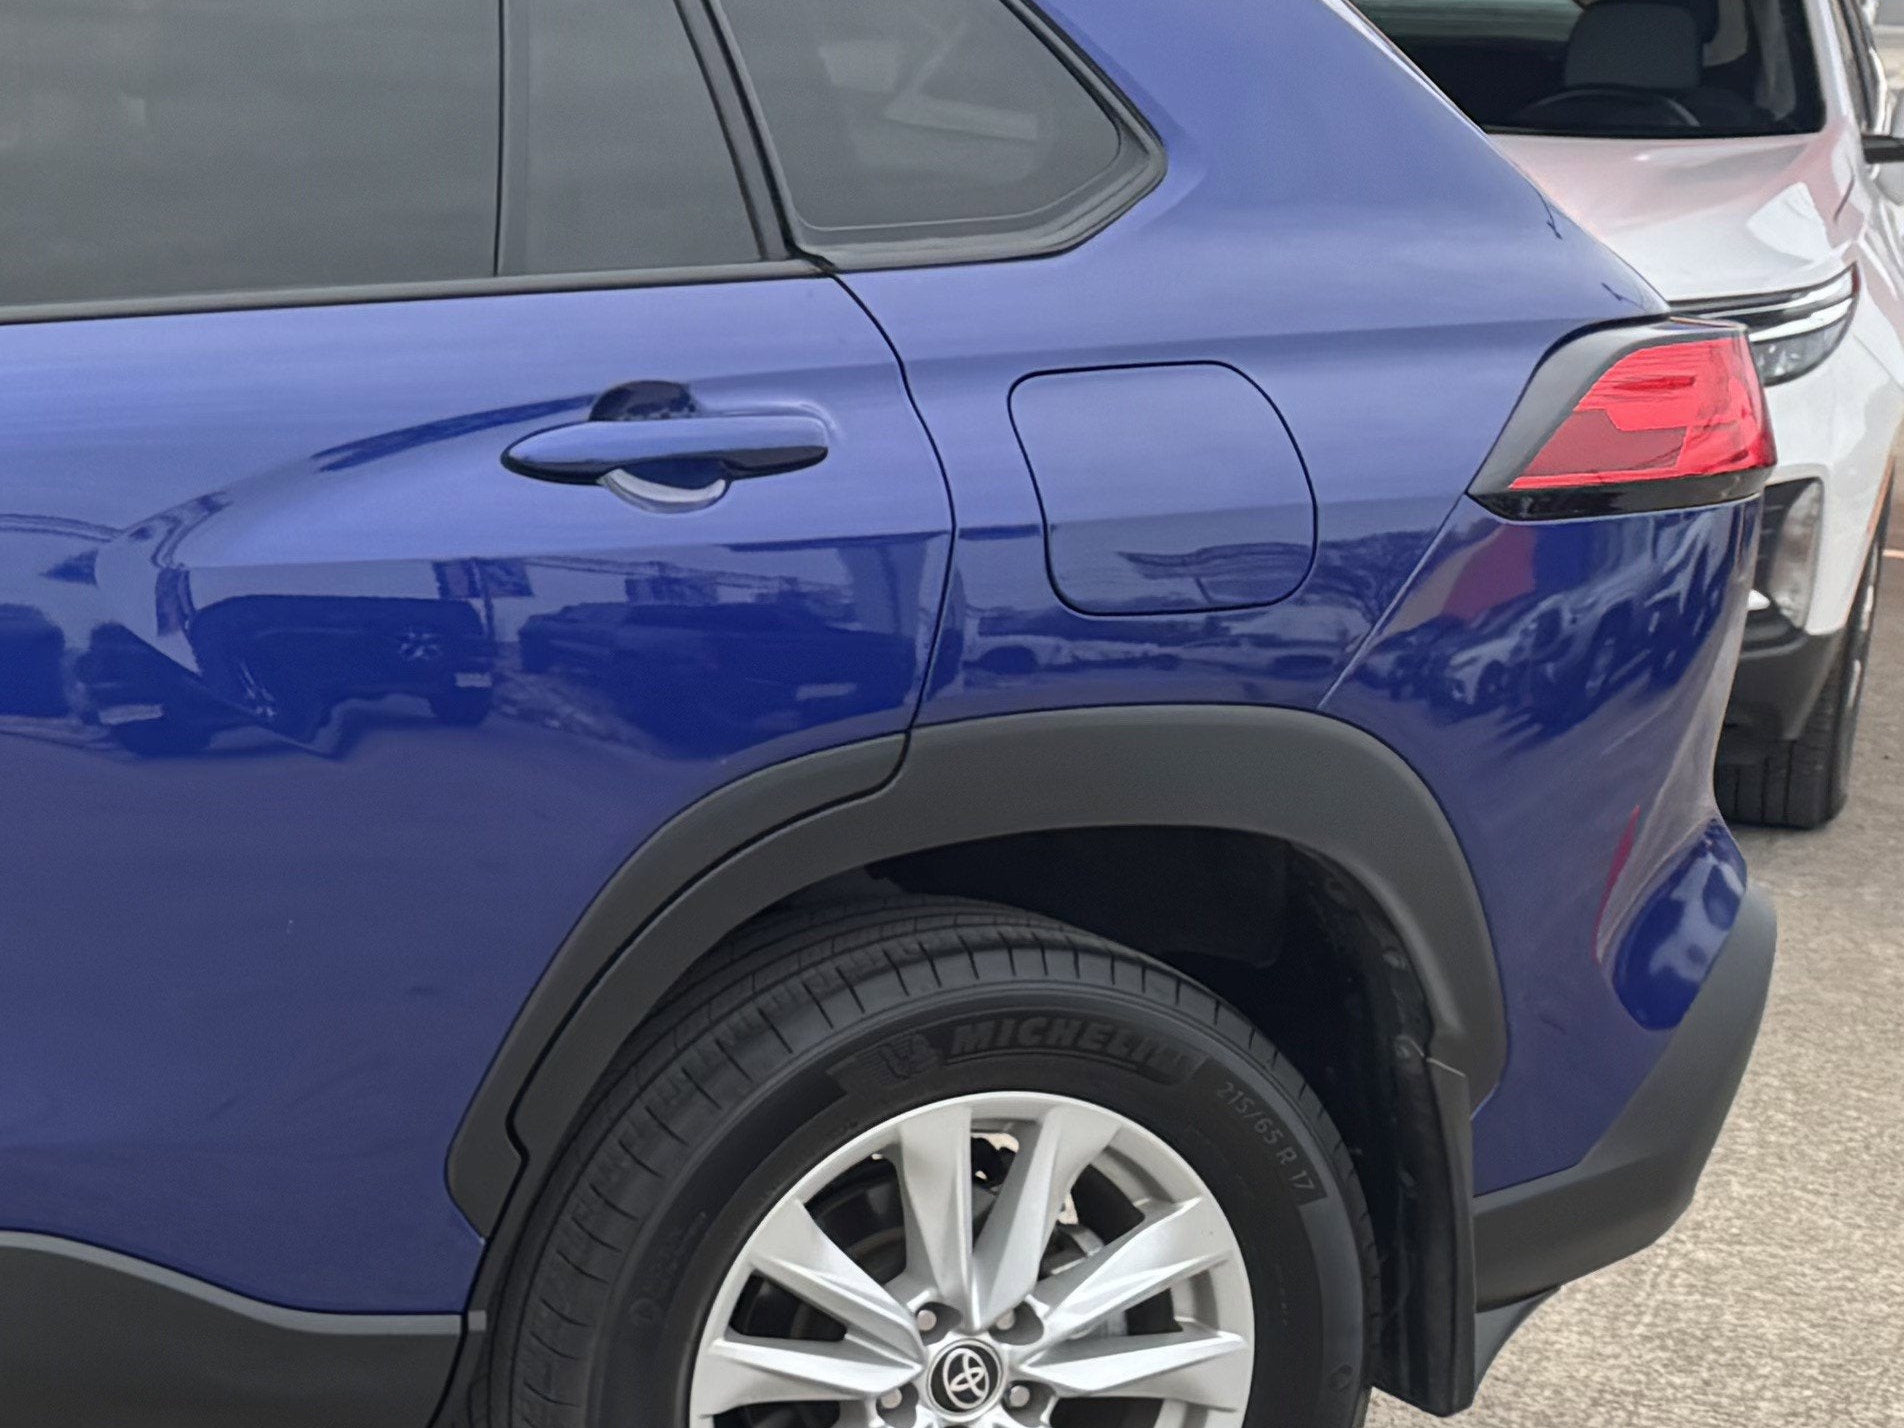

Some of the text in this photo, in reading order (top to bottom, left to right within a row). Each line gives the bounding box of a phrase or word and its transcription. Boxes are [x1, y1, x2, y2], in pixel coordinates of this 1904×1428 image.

[950, 1017, 1189, 1074] MICHELIN
[1217, 1081, 1315, 1190] 215/65 R 17
